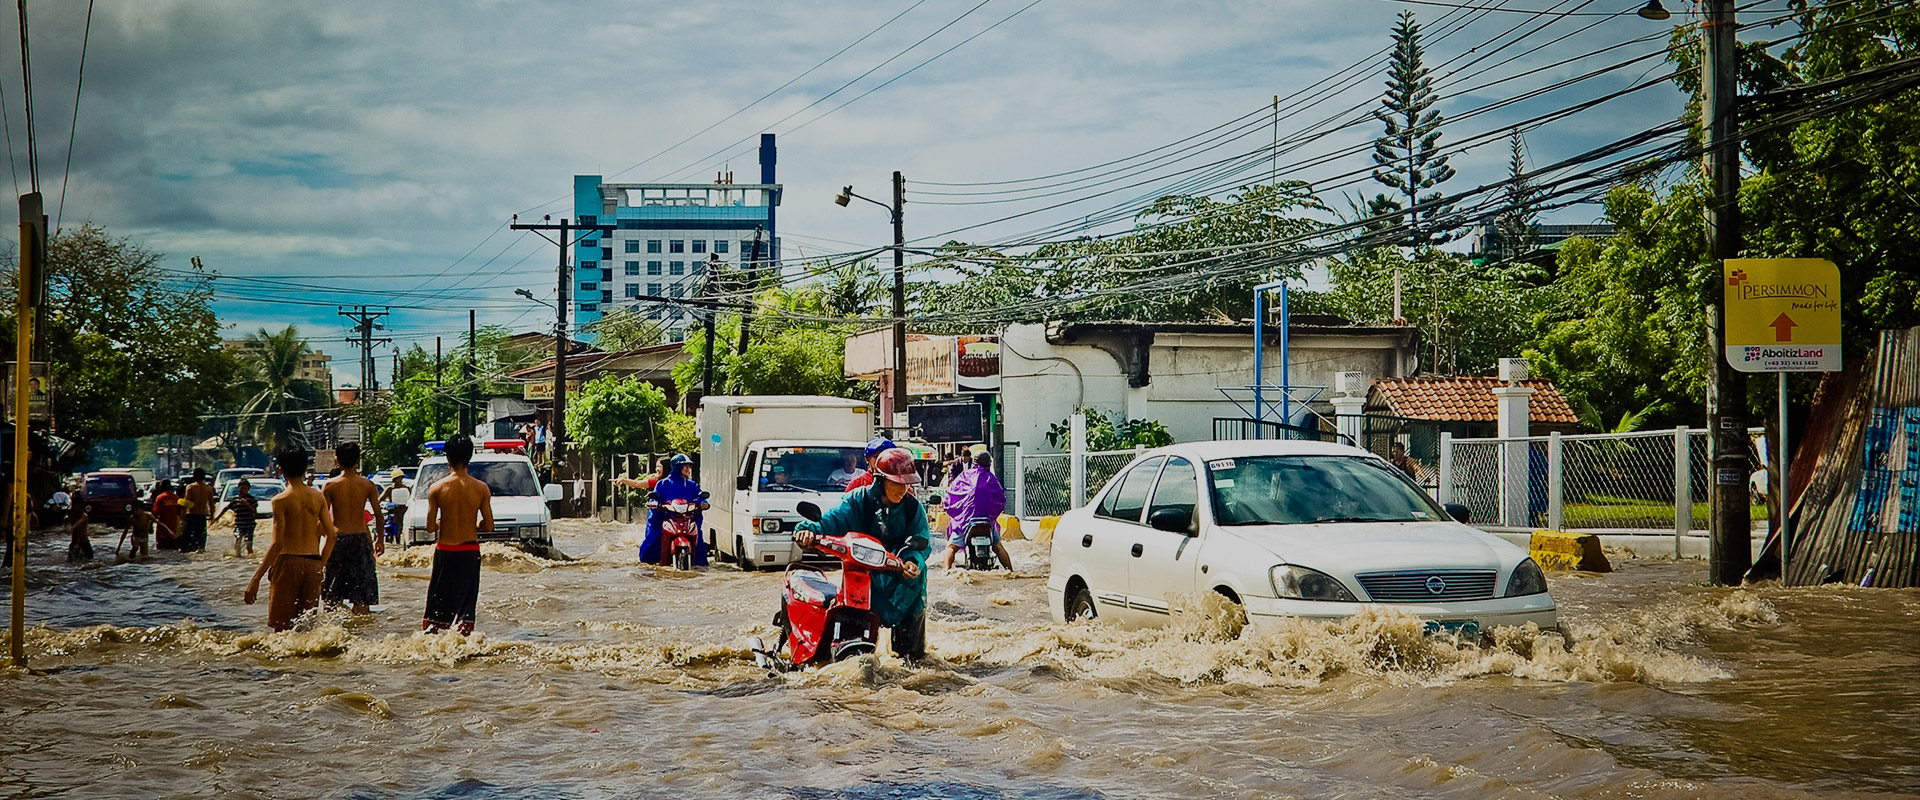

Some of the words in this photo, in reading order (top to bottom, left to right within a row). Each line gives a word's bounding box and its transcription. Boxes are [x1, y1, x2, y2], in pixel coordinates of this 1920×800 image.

[1743, 284, 1827, 300] PERSIMMON
[1813, 301, 1824, 312] for
[1762, 348, 1824, 358] AboitizLand
